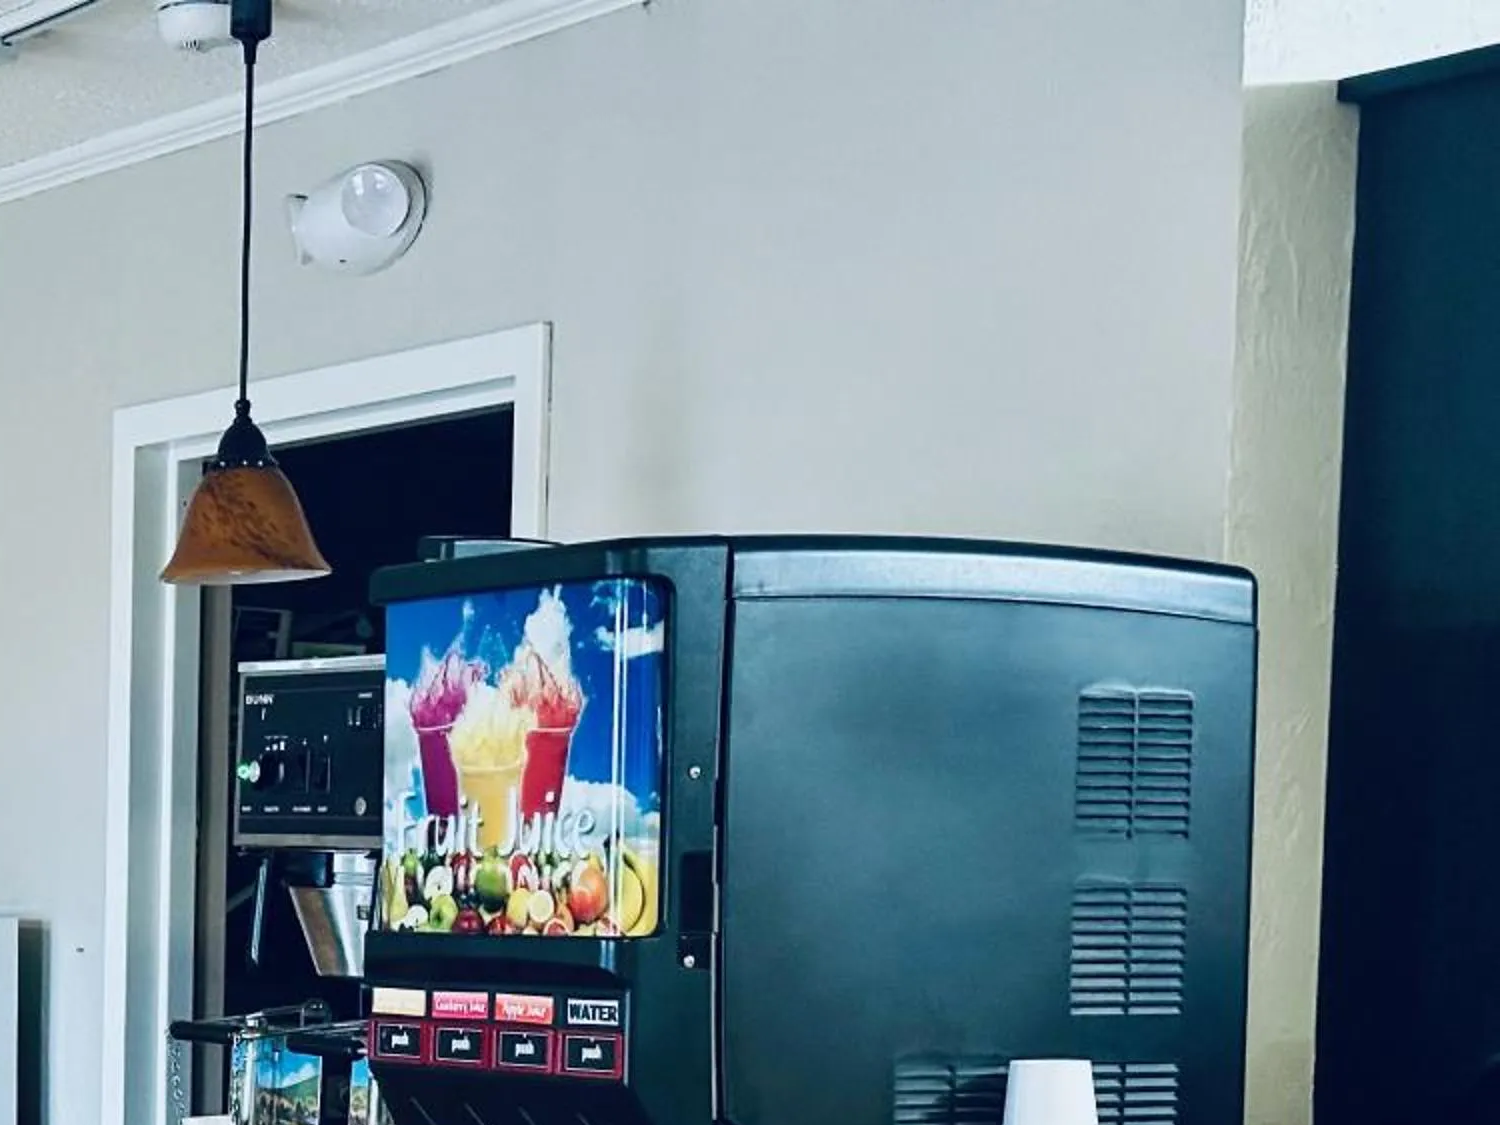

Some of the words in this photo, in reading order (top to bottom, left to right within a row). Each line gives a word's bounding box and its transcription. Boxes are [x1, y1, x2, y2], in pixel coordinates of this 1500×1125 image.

[245, 694, 274, 705] BUNN
[397, 791, 484, 857] Fruit
[499, 786, 597, 858] Juice
[571, 1003, 617, 1021] WATER
[391, 1031, 409, 1049] push
[451, 1035, 471, 1053] push
[515, 1039, 535, 1057] push
[581, 1043, 602, 1063] push
